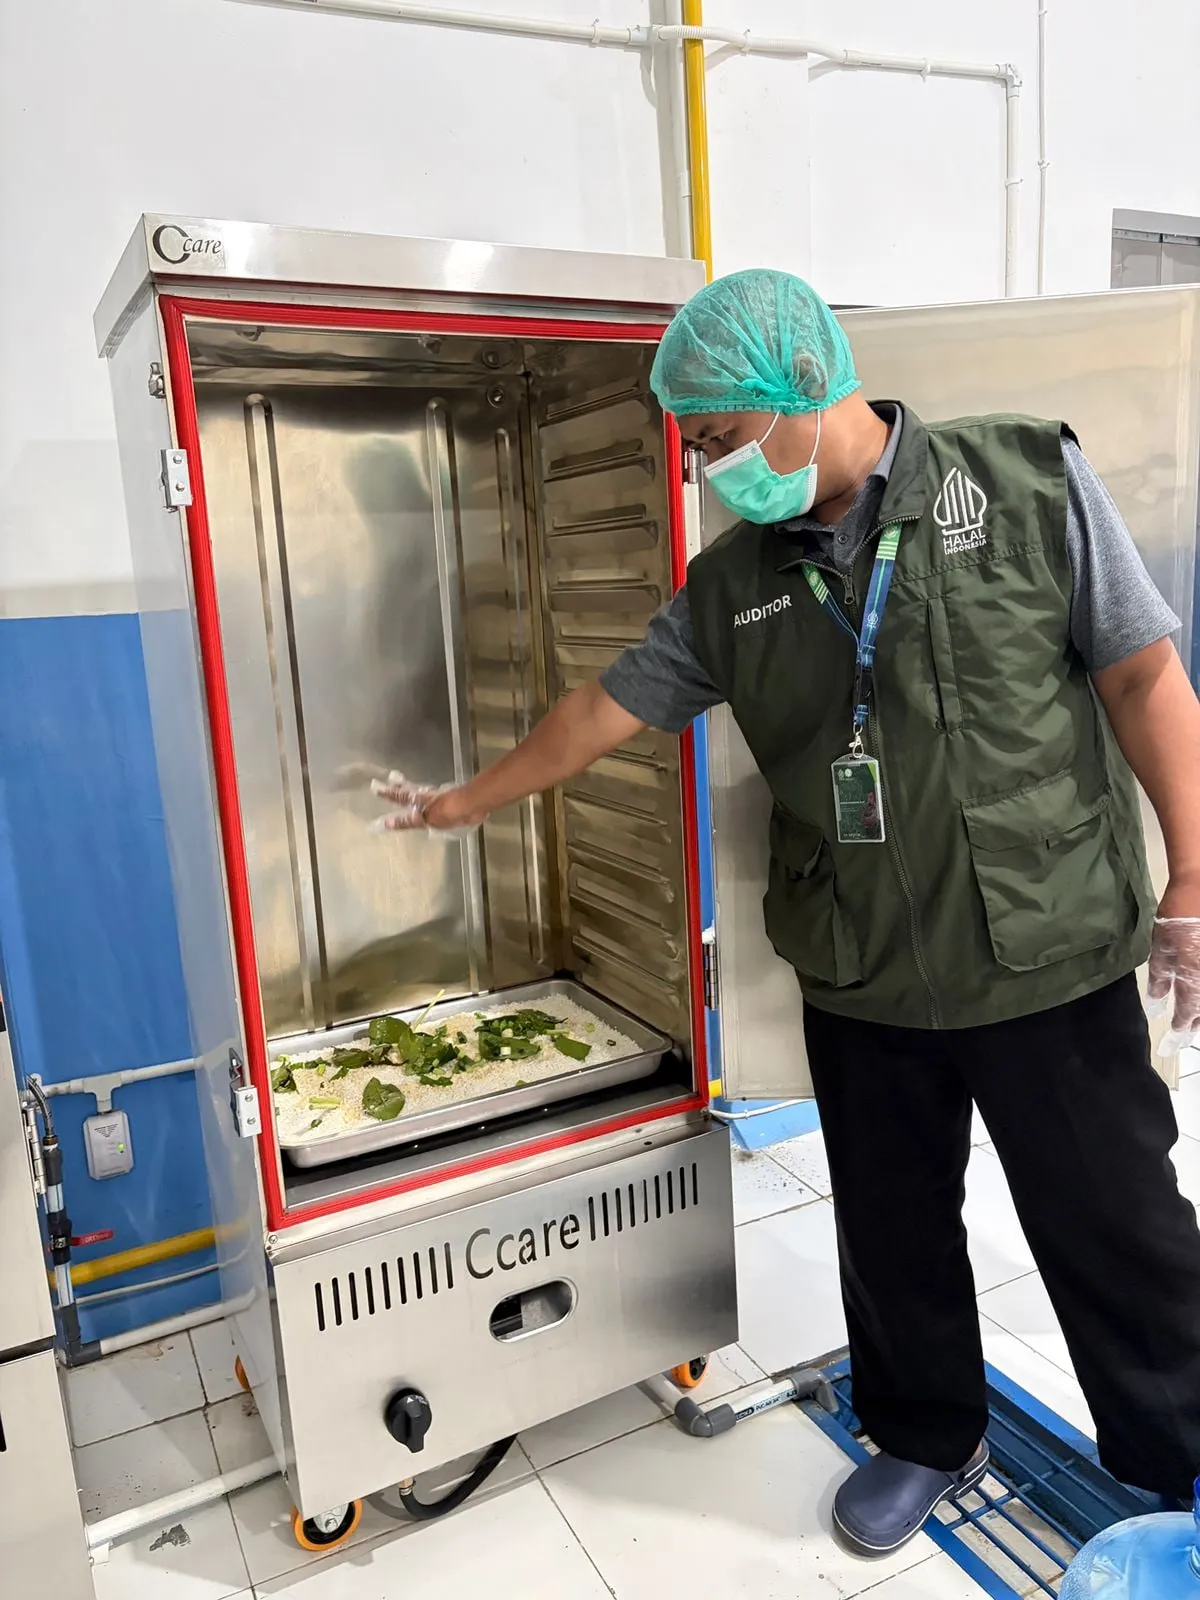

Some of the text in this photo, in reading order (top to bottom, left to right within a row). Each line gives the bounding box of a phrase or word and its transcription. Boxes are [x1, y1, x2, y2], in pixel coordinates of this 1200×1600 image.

[943, 528, 986, 548] HALAL
[944, 538, 987, 555] INDONESIA
[733, 594, 792, 629] AUDITOR
[465, 1213, 580, 1280] Ccare
